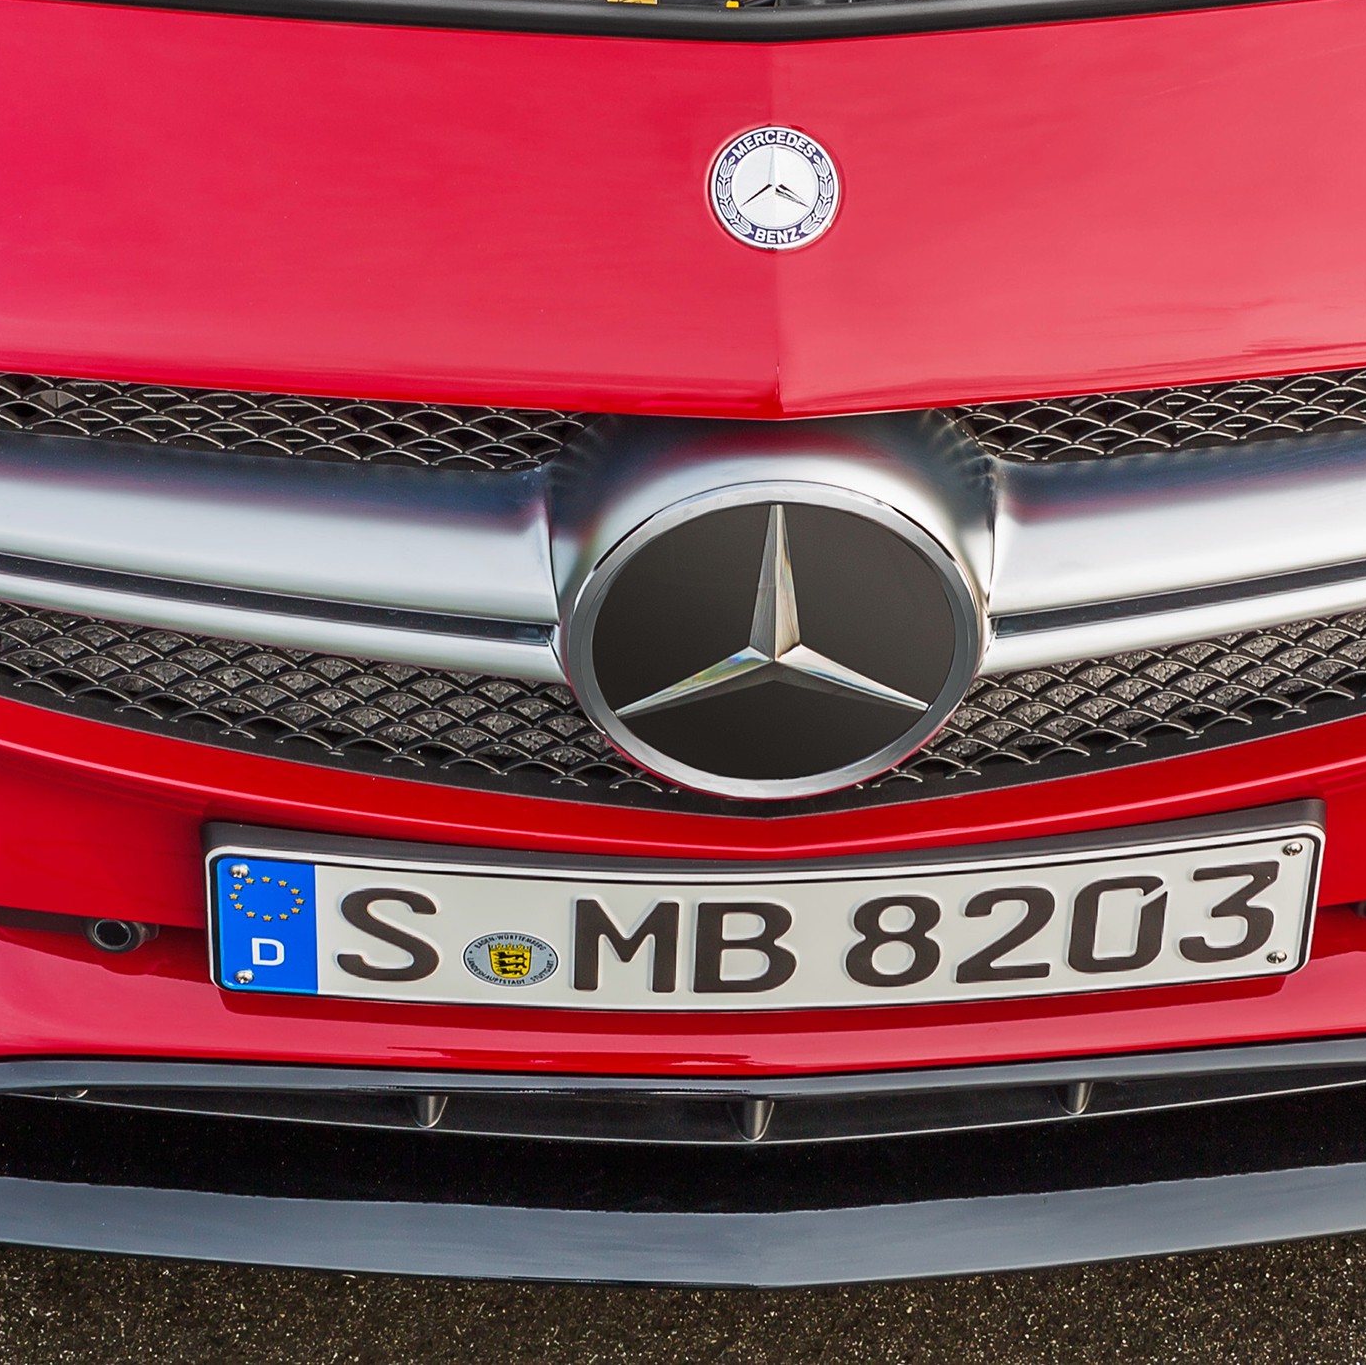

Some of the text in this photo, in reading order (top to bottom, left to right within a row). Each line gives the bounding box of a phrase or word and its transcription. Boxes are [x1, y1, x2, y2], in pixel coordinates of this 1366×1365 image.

[731, 130, 818, 159] MERCEDES
[754, 226, 802, 244] BENZ
[337, 860, 1281, 993] S MB 8203
[251, 937, 285, 966] D
